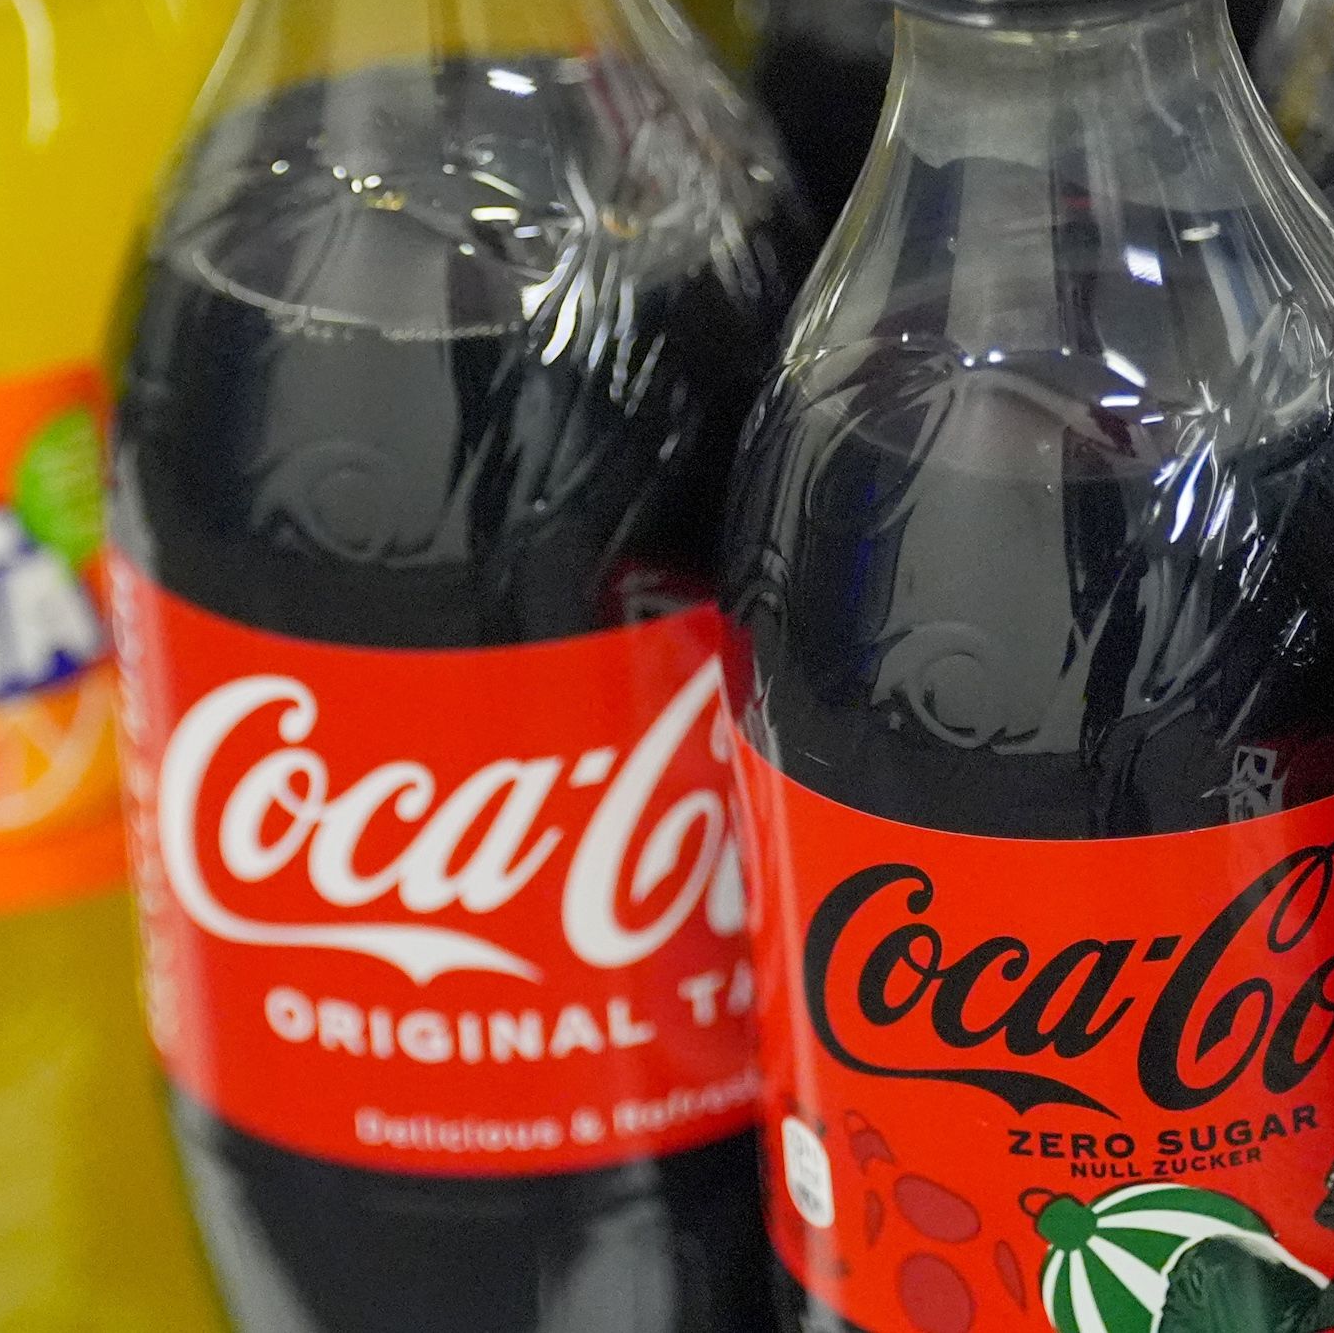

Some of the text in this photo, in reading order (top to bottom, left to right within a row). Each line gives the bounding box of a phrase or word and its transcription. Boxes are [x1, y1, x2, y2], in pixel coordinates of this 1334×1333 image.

[159, 654, 745, 986] Coca-C
[264, 986, 657, 1064] ORIGINAL
[1007, 1104, 1320, 1160] ZERO SUGAR
[1071, 1146, 1263, 1179] NULL ZUCKER
